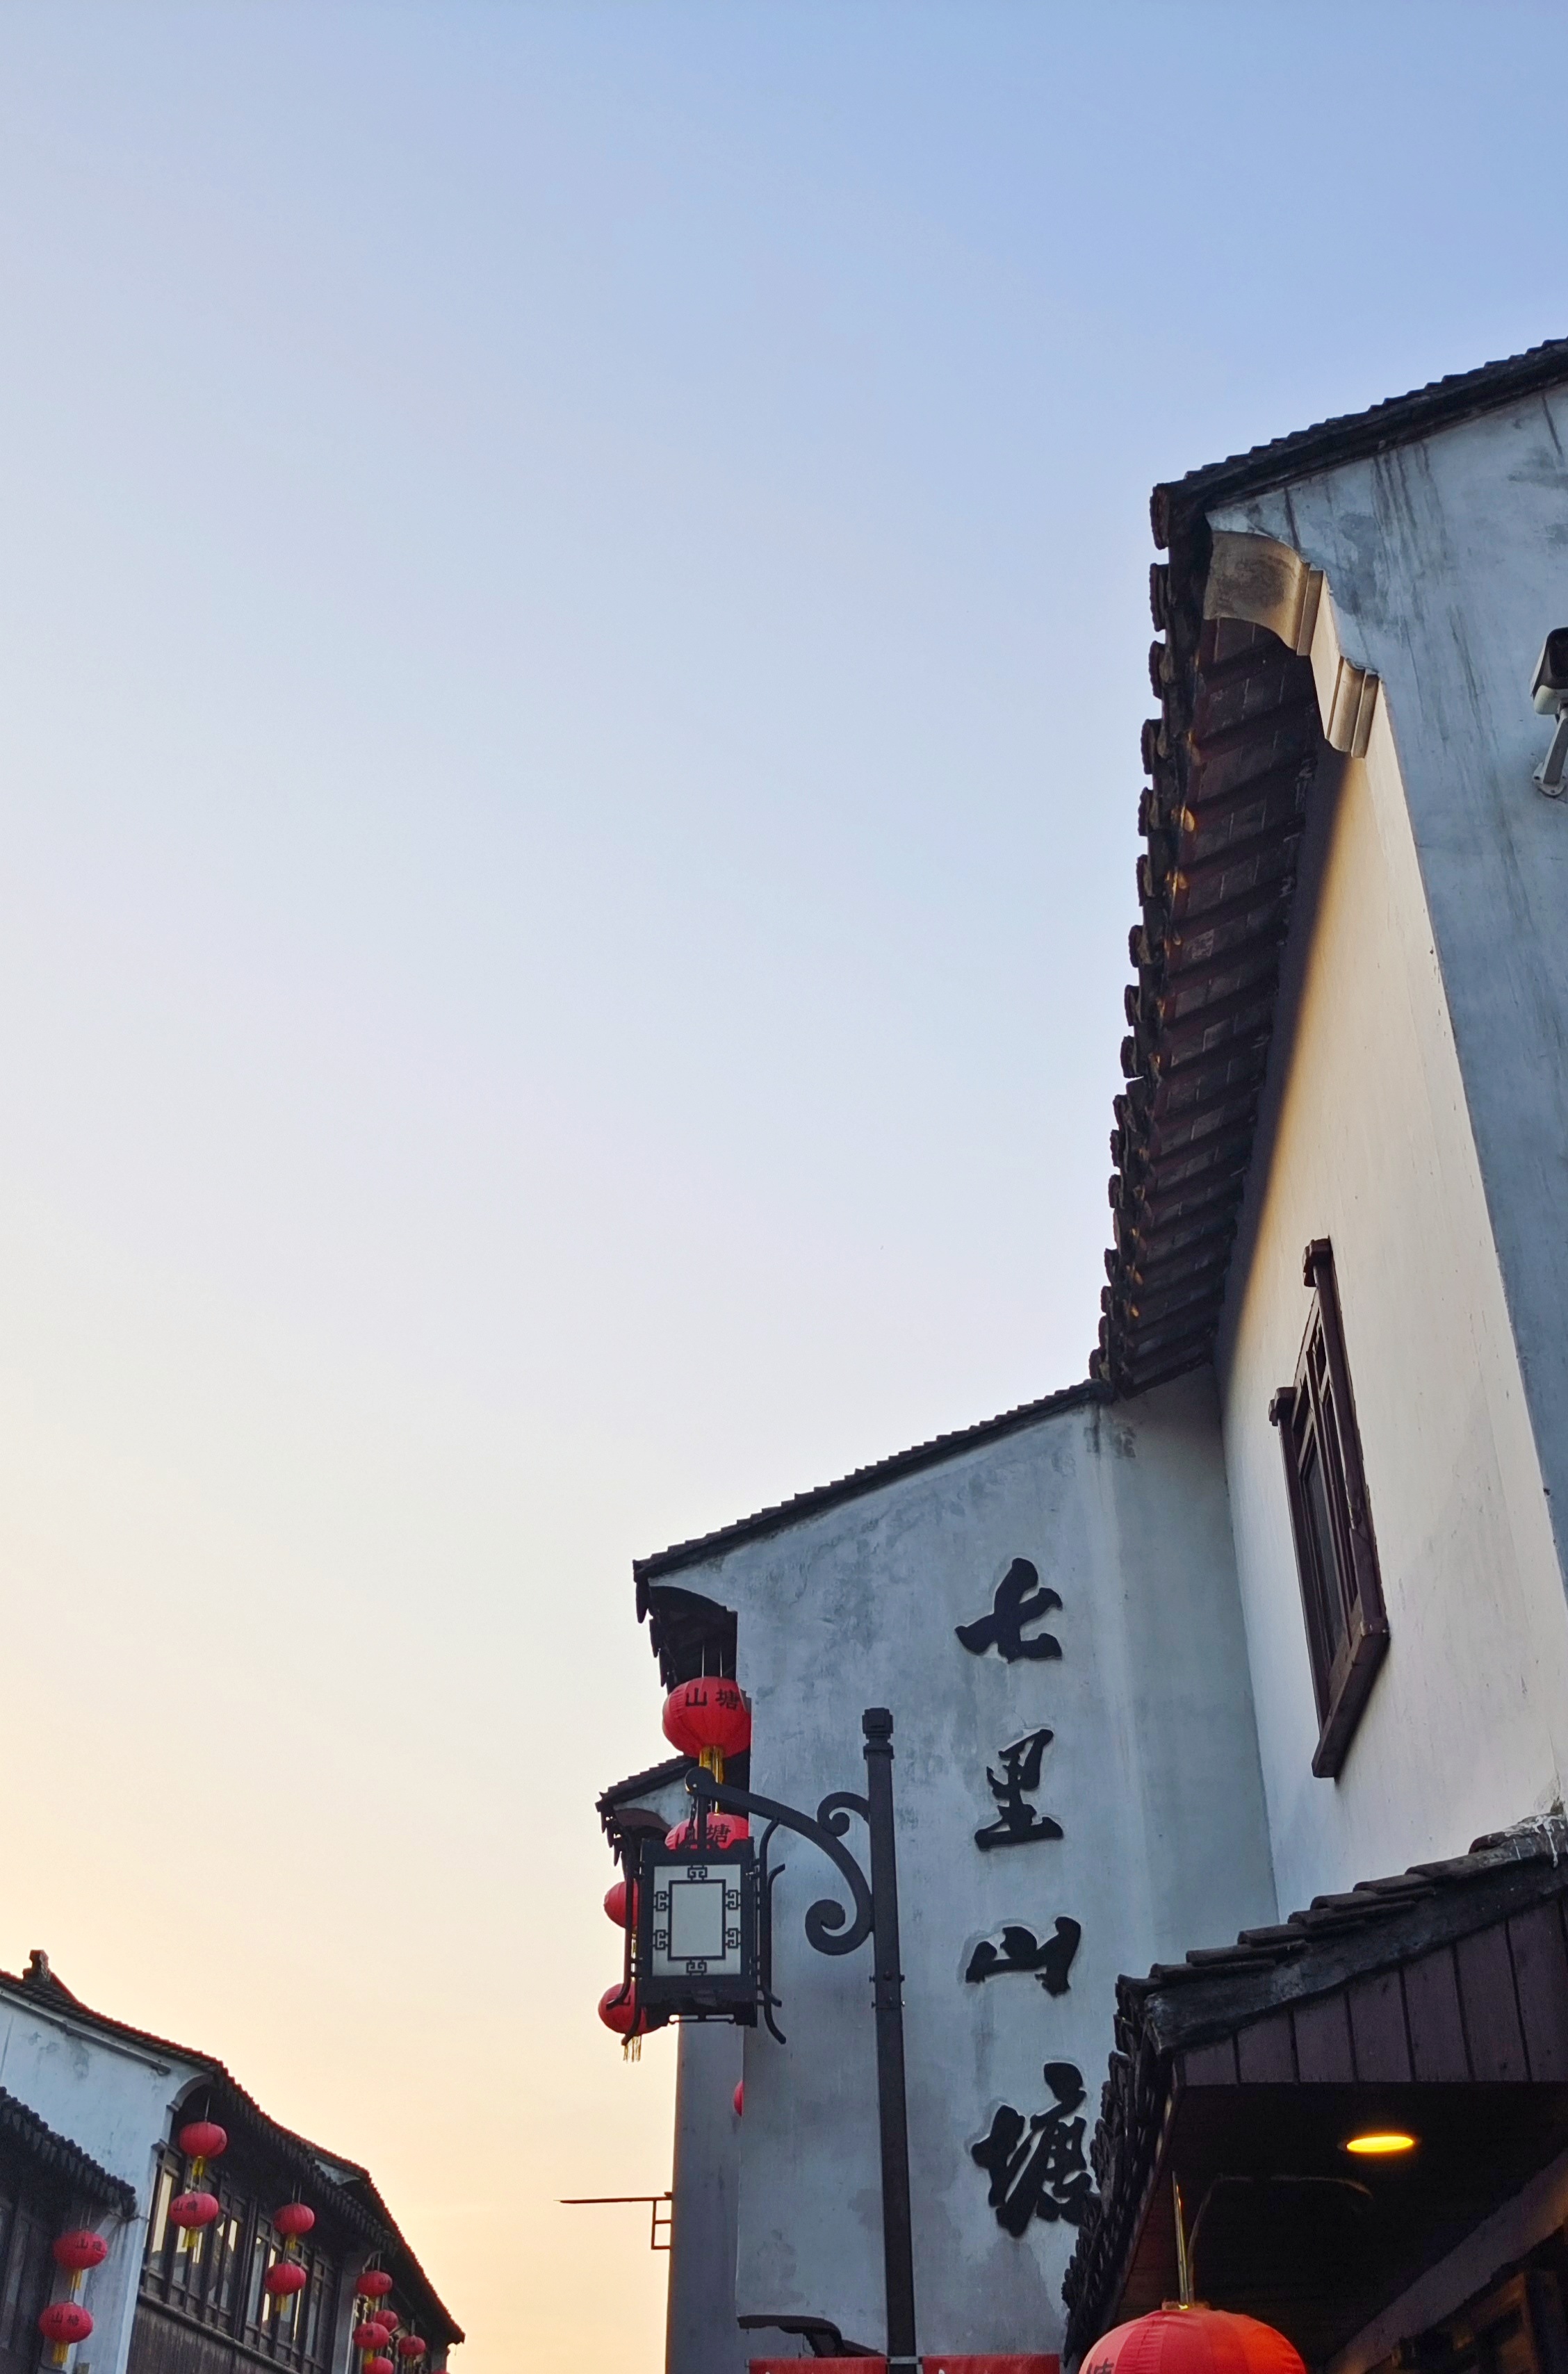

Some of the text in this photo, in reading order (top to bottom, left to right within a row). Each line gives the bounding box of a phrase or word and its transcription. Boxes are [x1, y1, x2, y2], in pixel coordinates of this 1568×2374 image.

[685, 1687, 740, 1710] 山塘
[954, 1557, 1094, 2238] 七里山塘
